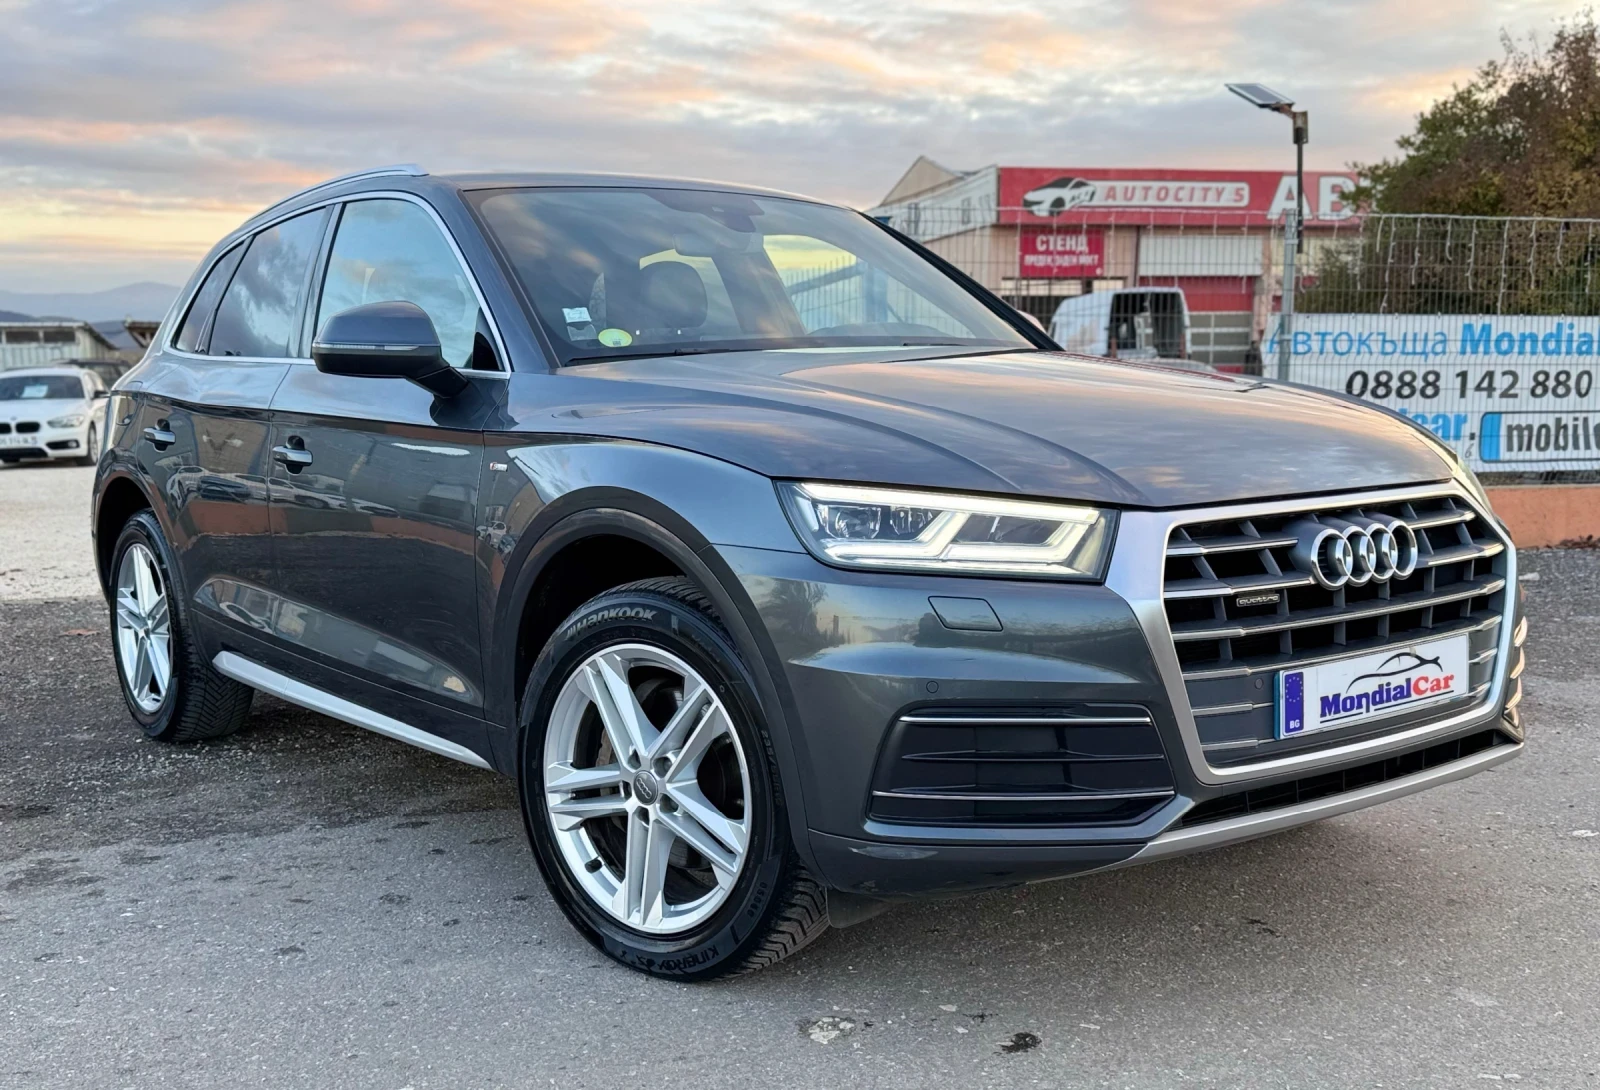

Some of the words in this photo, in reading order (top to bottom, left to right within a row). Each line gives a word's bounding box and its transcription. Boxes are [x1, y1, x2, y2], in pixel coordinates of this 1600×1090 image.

[1104, 185, 1226, 202] AUTOCITY
[1266, 175, 1358, 220] АВ
[1035, 234, 1089, 253] СТЕНД
[1345, 369, 1441, 399] 0888
[1455, 370, 1519, 398] 142
[1530, 369, 1593, 398] 880
[1319, 673, 1455, 718] MondialCar
[1289, 719, 1300, 729] BG
